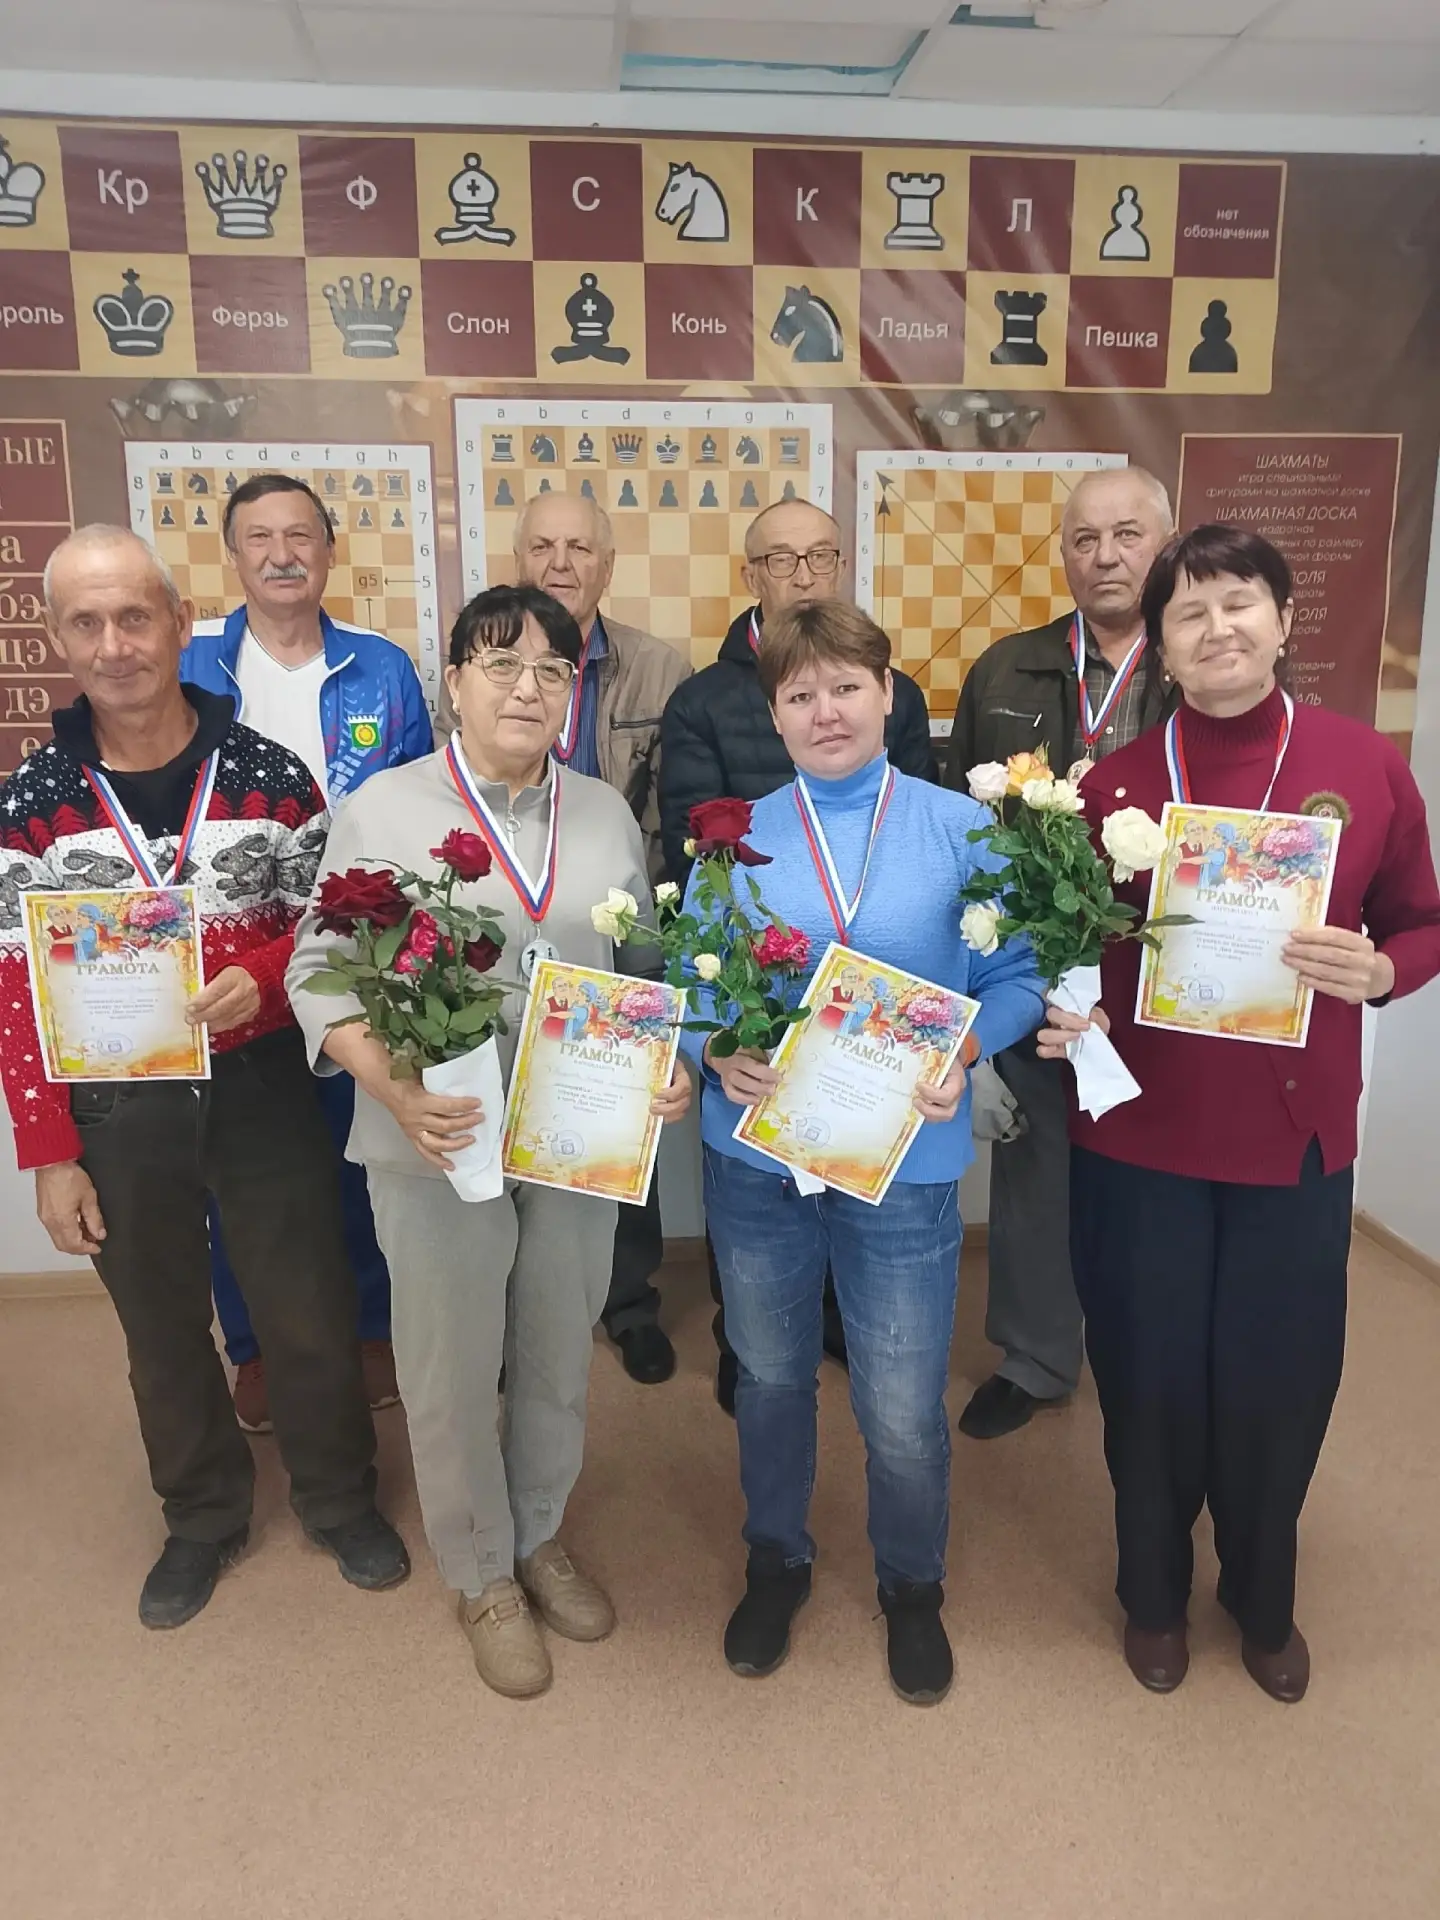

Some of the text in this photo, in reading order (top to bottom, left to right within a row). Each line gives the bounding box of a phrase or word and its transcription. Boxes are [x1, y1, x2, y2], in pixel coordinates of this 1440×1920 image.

[98, 168, 149, 214] Кр
[346, 175, 378, 211] Ф
[572, 176, 601, 212] С
[796, 187, 819, 222] К
[1006, 198, 1033, 233] Л
[1216, 209, 1239, 221] нет
[1183, 224, 1270, 240] обозначения
[0, 305, 64, 329] роль
[212, 305, 289, 329] Ферзь
[447, 312, 510, 334] Слон
[671, 312, 727, 334] Конь
[877, 317, 948, 342] Ладья
[1084, 325, 1158, 348] Пешка
[497, 406, 794, 424] a b c d e f g h
[0, 437, 56, 465] ЫЕ
[465, 439, 474, 453] 8
[817, 442, 826, 456] 8
[159, 446, 398, 464] a b c d e f g h
[917, 455, 925, 465] b
[976, 456, 984, 467] d
[1005, 458, 1013, 467] e
[1256, 454, 1329, 468] ШАХМАТЫ
[133, 476, 144, 490] 8
[417, 479, 427, 493] 8
[468, 483, 475, 496] 7
[818, 485, 825, 498] 7
[137, 508, 145, 522] 7
[419, 511, 428, 525] 7
[1216, 506, 1358, 520] ШАХМАТНАЯ ДОСКА
[469, 526, 478, 539] 6
[420, 544, 430, 557] 6
[358, 573, 378, 589] g5
[422, 575, 431, 589] 5
[471, 569, 479, 582] 5
[423, 606, 433, 619] 4
[1294, 607, 1328, 621] ОЛЯ
[425, 637, 435, 652] 3
[426, 668, 436, 683] 2
[4, 686, 50, 721] дэ
[428, 699, 437, 712] 1
[1196, 888, 1280, 912] ГРАМОТА
[76, 962, 160, 975] ГРАМОТА
[560, 1042, 633, 1068] ГРАМОТА
[831, 1034, 903, 1073] ГРАМОТА
